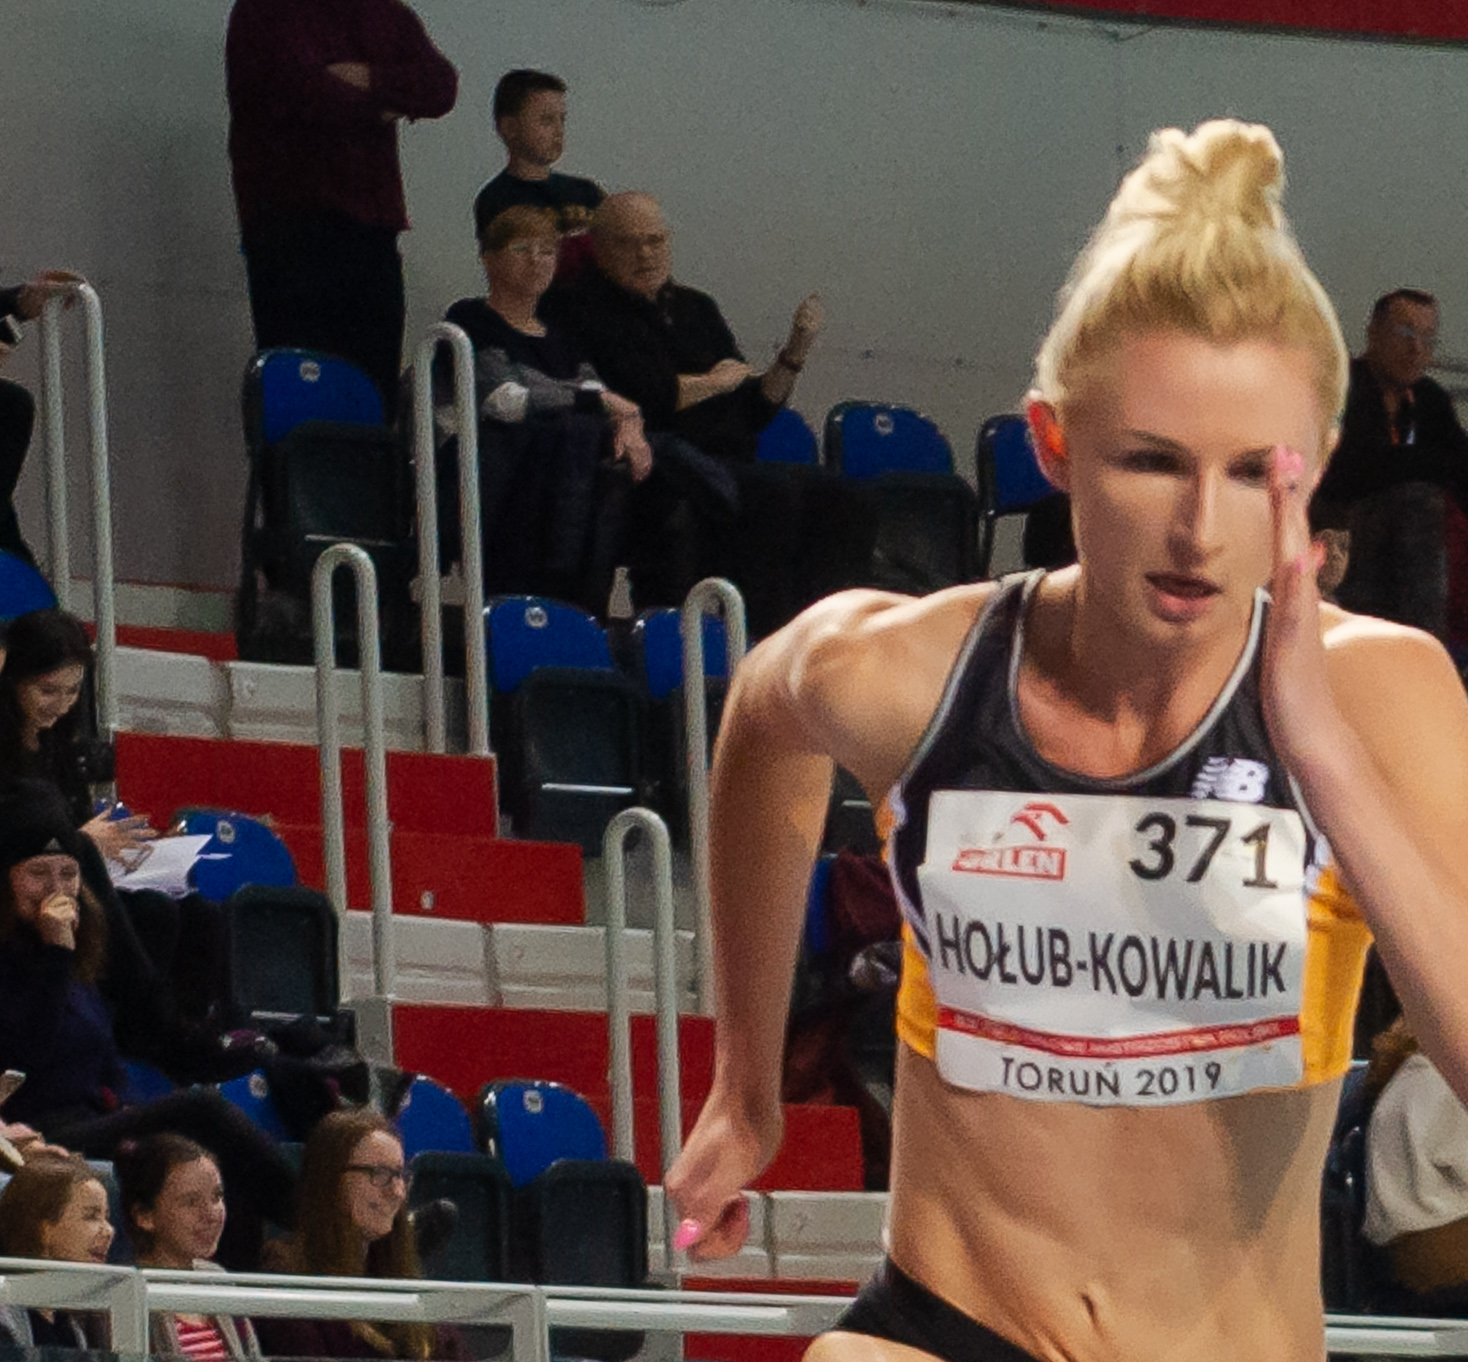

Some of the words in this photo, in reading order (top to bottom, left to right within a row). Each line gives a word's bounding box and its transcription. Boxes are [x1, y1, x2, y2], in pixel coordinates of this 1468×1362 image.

[1128, 811, 1278, 889] 371
[935, 912, 1288, 1001] HOŁUB-KOWALIK
[1137, 1061, 1222, 1097] 2019
